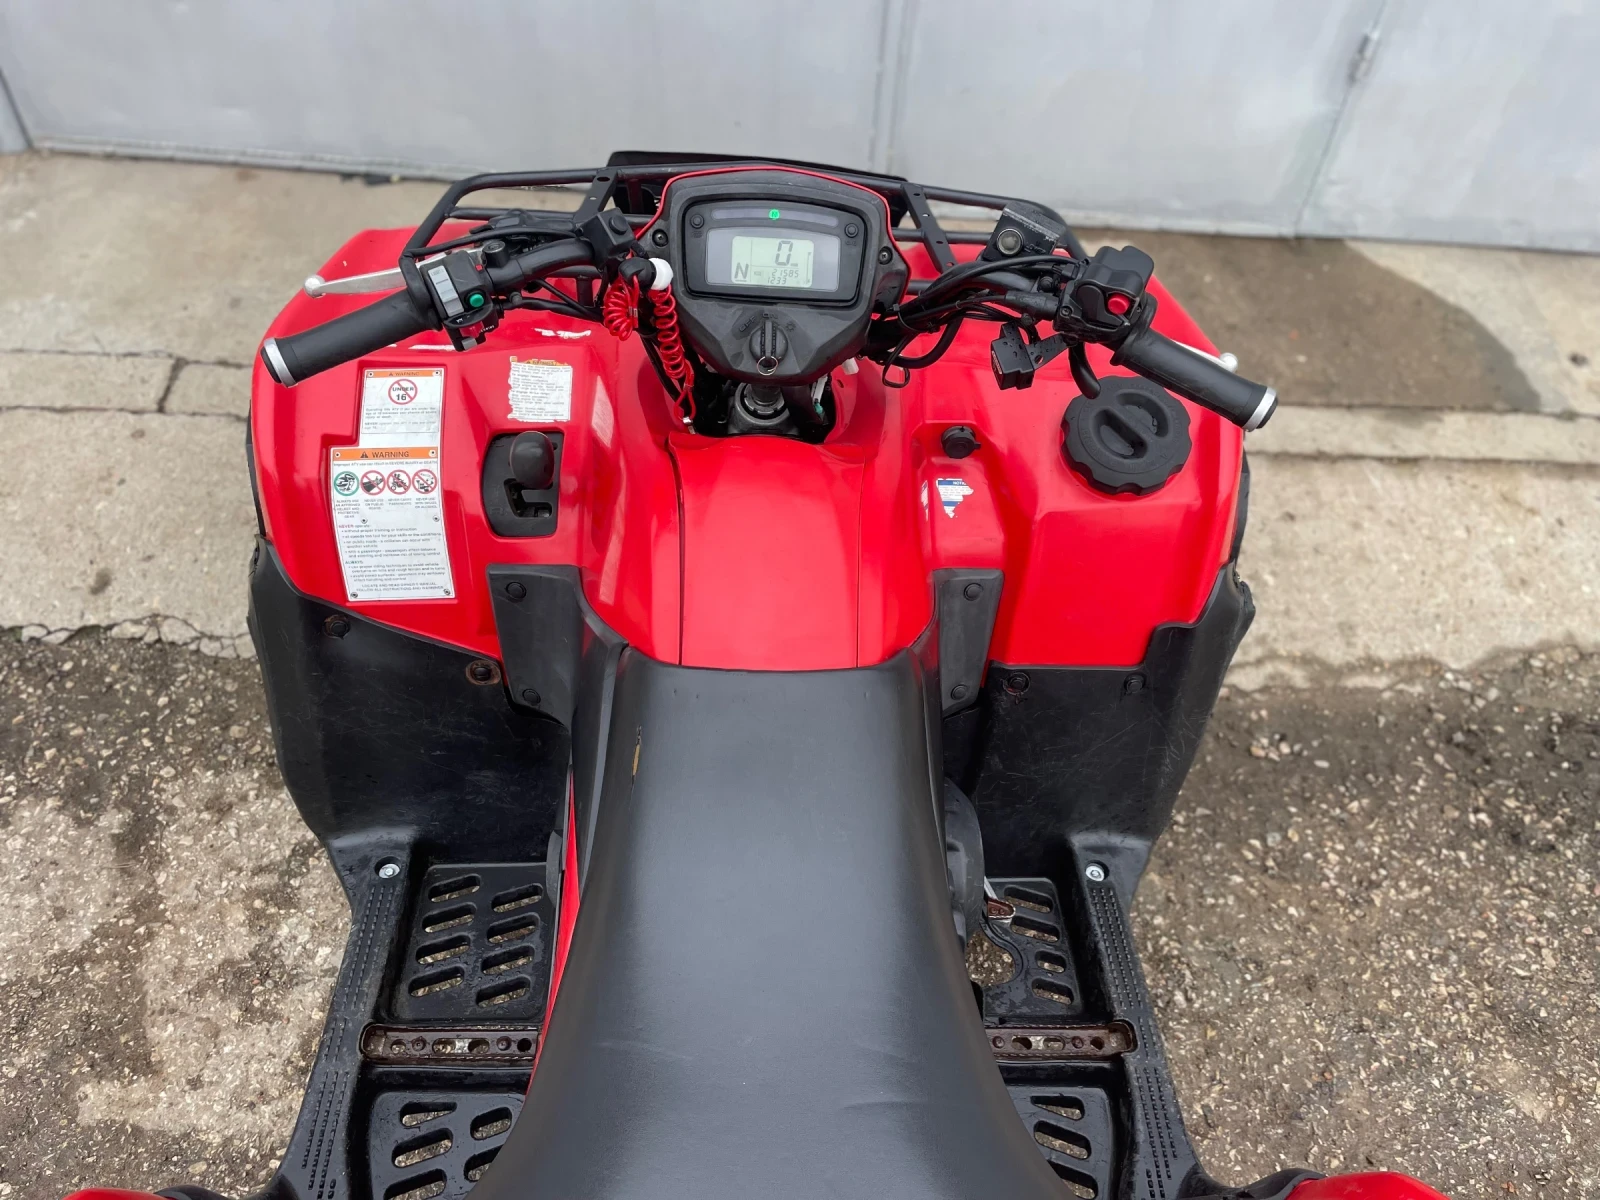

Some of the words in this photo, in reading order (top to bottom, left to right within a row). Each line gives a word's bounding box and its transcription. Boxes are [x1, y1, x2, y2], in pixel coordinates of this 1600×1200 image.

[734, 262, 749, 279] N
[771, 268, 799, 278] 21585
[767, 276, 787, 285] 1233
[396, 393, 407, 401] 16
